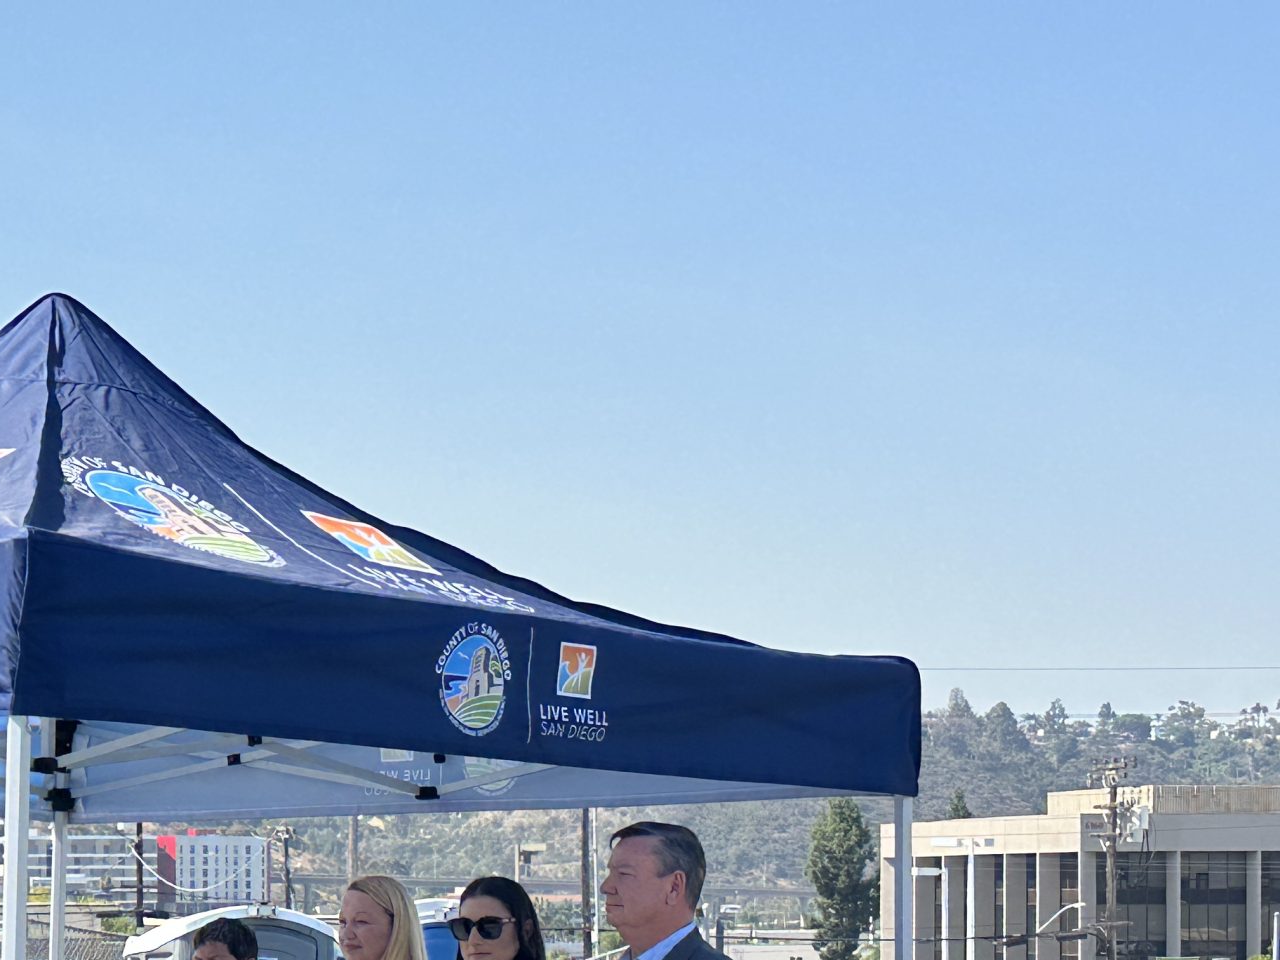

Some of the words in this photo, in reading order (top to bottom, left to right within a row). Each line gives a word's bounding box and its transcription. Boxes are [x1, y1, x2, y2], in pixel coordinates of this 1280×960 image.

[111, 460, 165, 486] SAN
[171, 483, 251, 533] DIEGO
[435, 626, 466, 674] COUNTY
[467, 622, 479, 633] OF
[480, 623, 500, 643] SAN
[496, 638, 512, 681] DIEGO
[539, 704, 569, 722] LIVE
[573, 708, 609, 726] WELL
[540, 721, 563, 737] SAN
[568, 724, 607, 742] DIEGO
